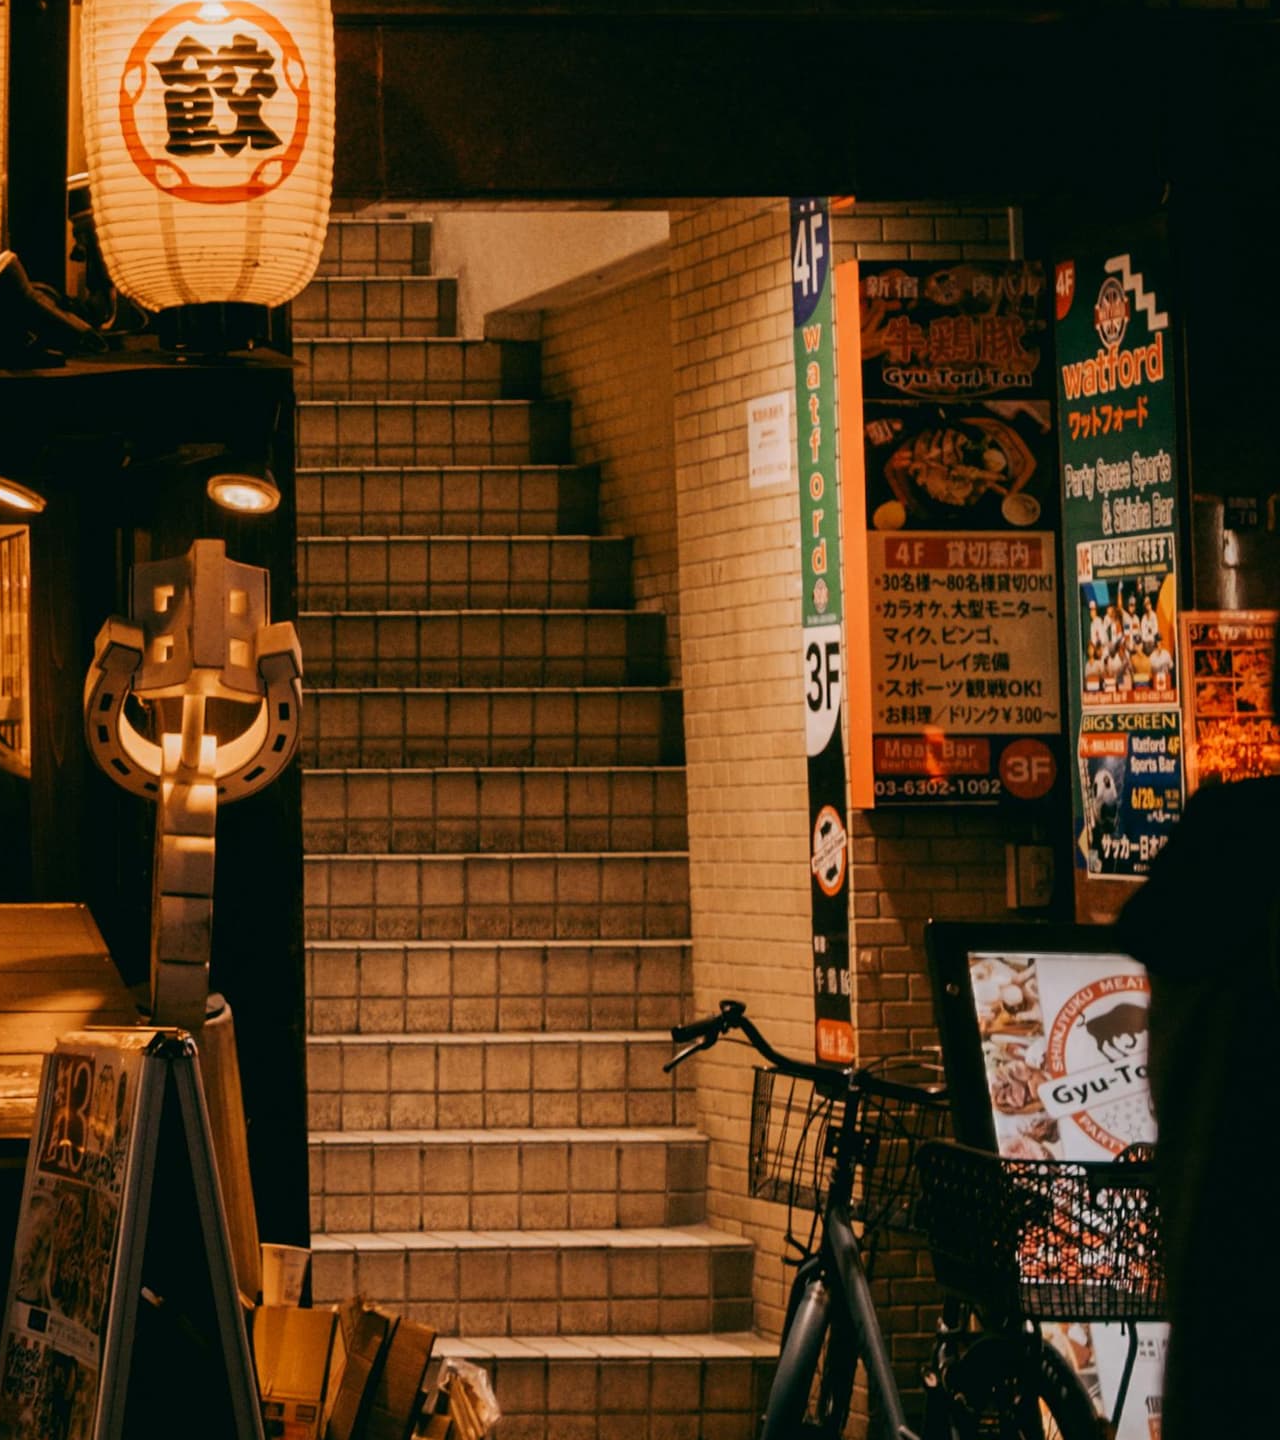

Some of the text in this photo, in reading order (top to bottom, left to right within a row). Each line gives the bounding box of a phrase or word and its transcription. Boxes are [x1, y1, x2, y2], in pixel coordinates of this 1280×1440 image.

[792, 212, 824, 300] 4F
[1055, 268, 1074, 297] 4F
[1062, 330, 1165, 401] watford
[1067, 395, 1149, 441] ワットフォード
[802, 323, 829, 576] watford
[1064, 448, 1172, 501] Party Space Sports
[1152, 491, 1175, 528] Bar
[895, 541, 1031, 568] 4F 貸切案内
[804, 640, 842, 714] 3F
[1116, 713, 1178, 731] SCREEN
[874, 779, 1002, 797] 03-6302-1092
[1005, 756, 1052, 784] 3F
[1099, 976, 1146, 994] MEAT
